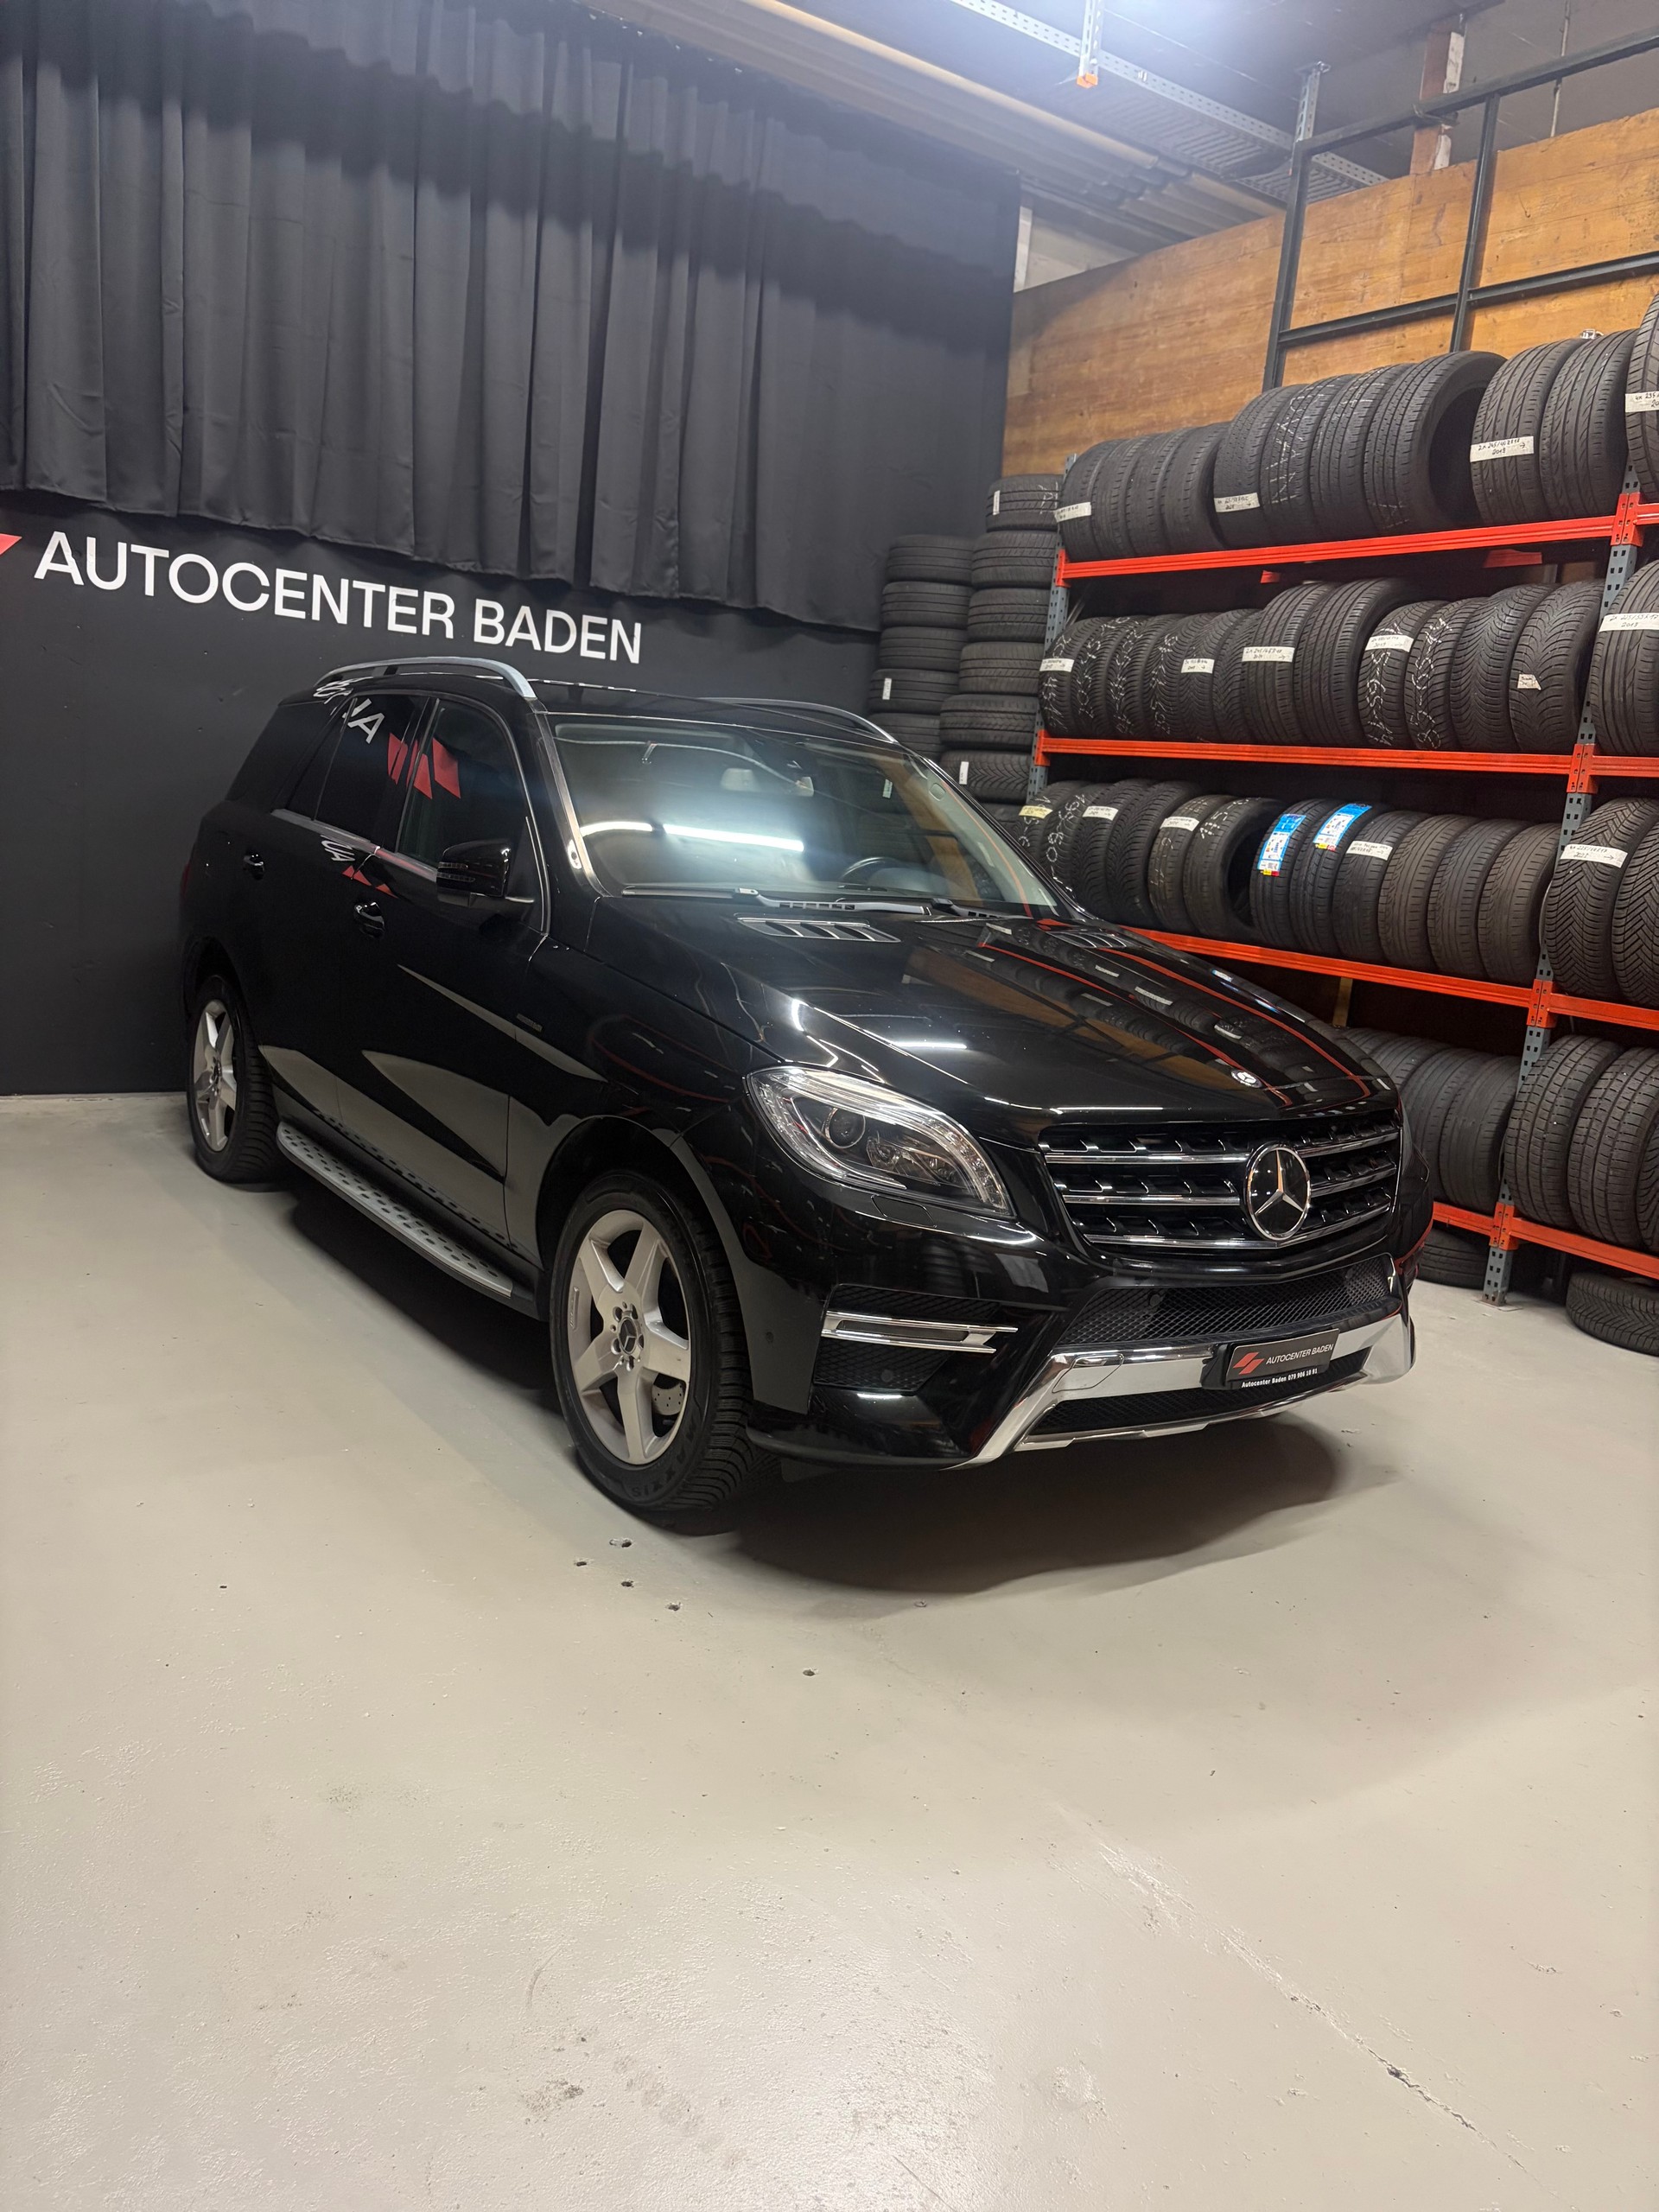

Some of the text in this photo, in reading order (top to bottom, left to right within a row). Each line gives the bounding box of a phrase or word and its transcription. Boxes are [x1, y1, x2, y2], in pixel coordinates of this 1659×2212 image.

[34, 531, 642, 664] AUTOCENTER BADEN
[1266, 1343, 1334, 1364] AUTOCENTER BADEN
[1241, 1379, 1271, 1389] Autocenter
